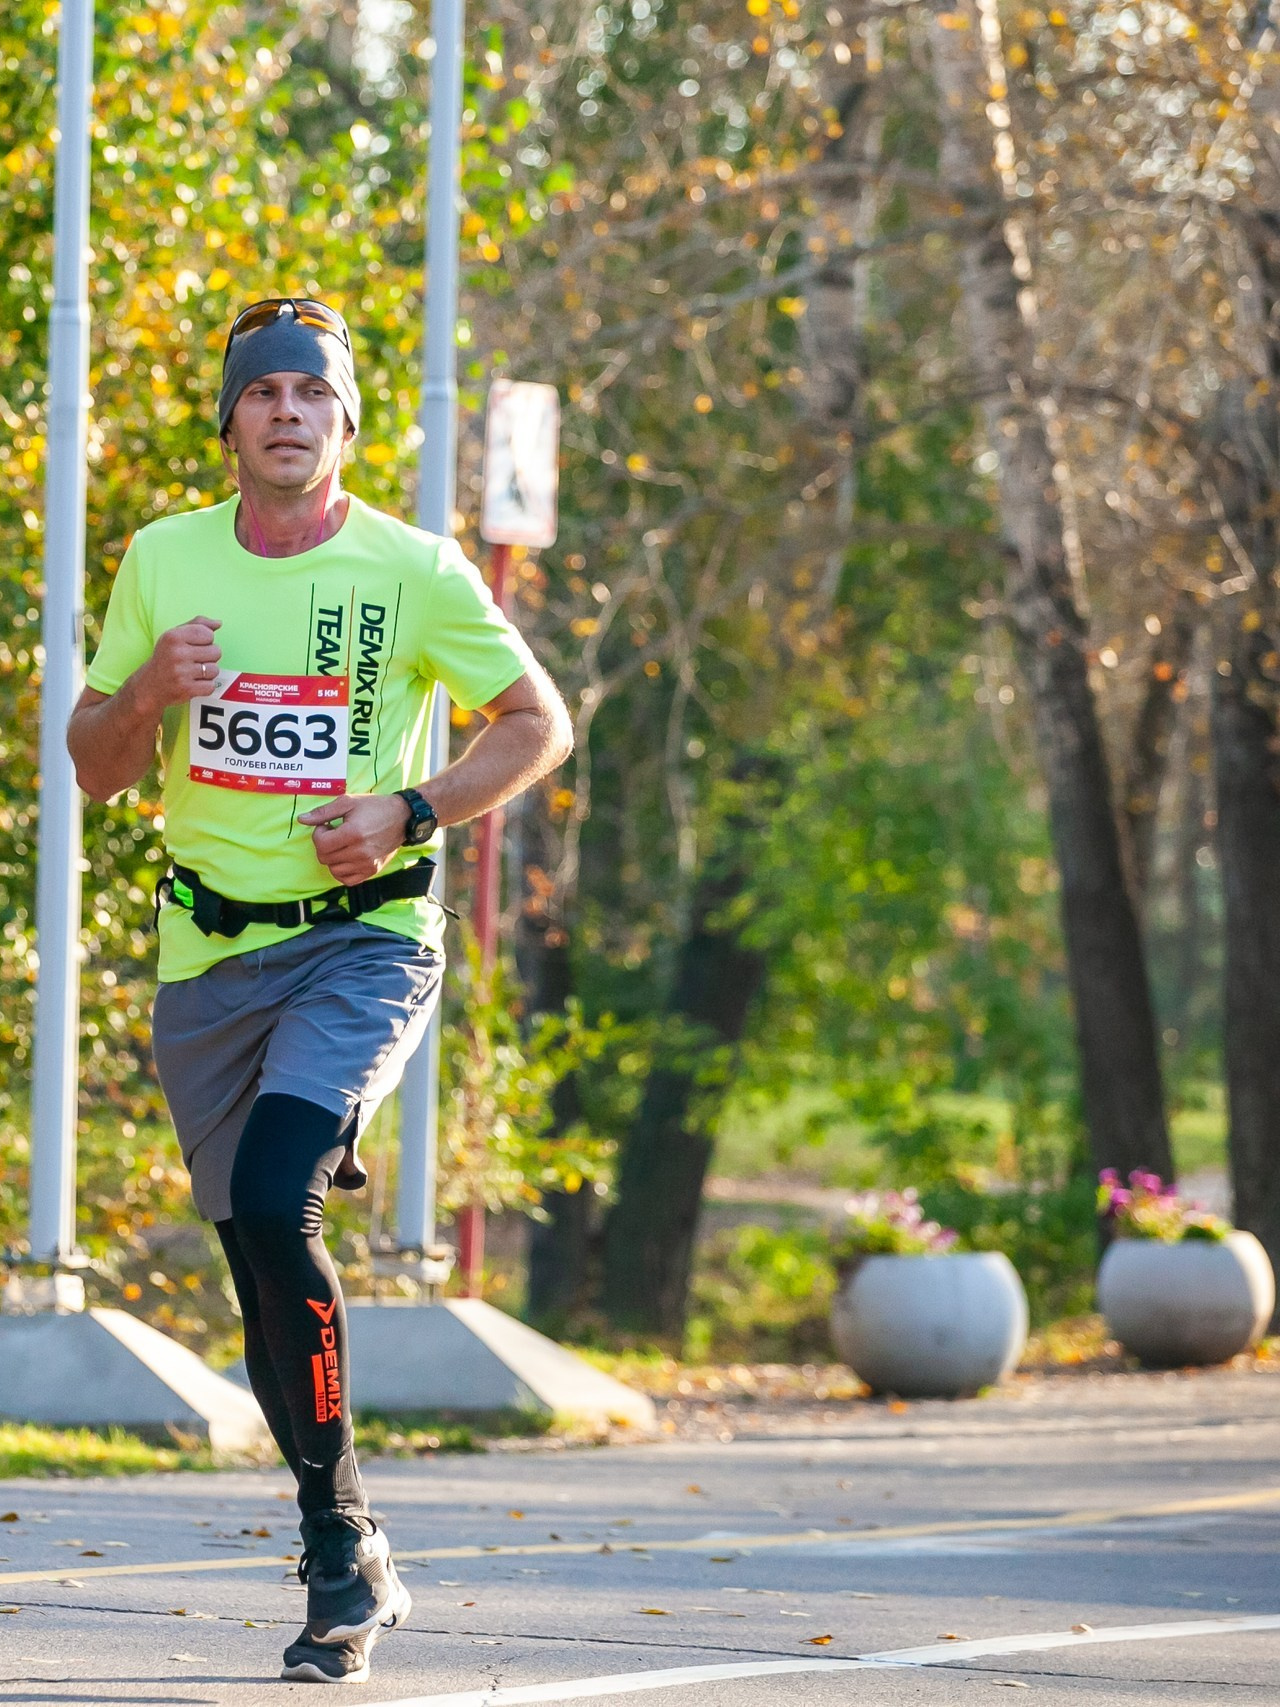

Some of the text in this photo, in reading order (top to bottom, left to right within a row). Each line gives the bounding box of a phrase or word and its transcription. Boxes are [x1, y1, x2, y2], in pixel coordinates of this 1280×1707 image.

[349, 602, 385, 756] DEMIX RUN
[239, 682, 299, 692] КРАСНОЯРСКИЕ
[254, 690, 282, 698] МОСТЫ
[317, 689, 323, 697] 5
[198, 704, 337, 760] 5663
[224, 757, 303, 772] ГОЛУБЕВ ПАВЕЛ
[321, 1326, 341, 1419] DEMIX
